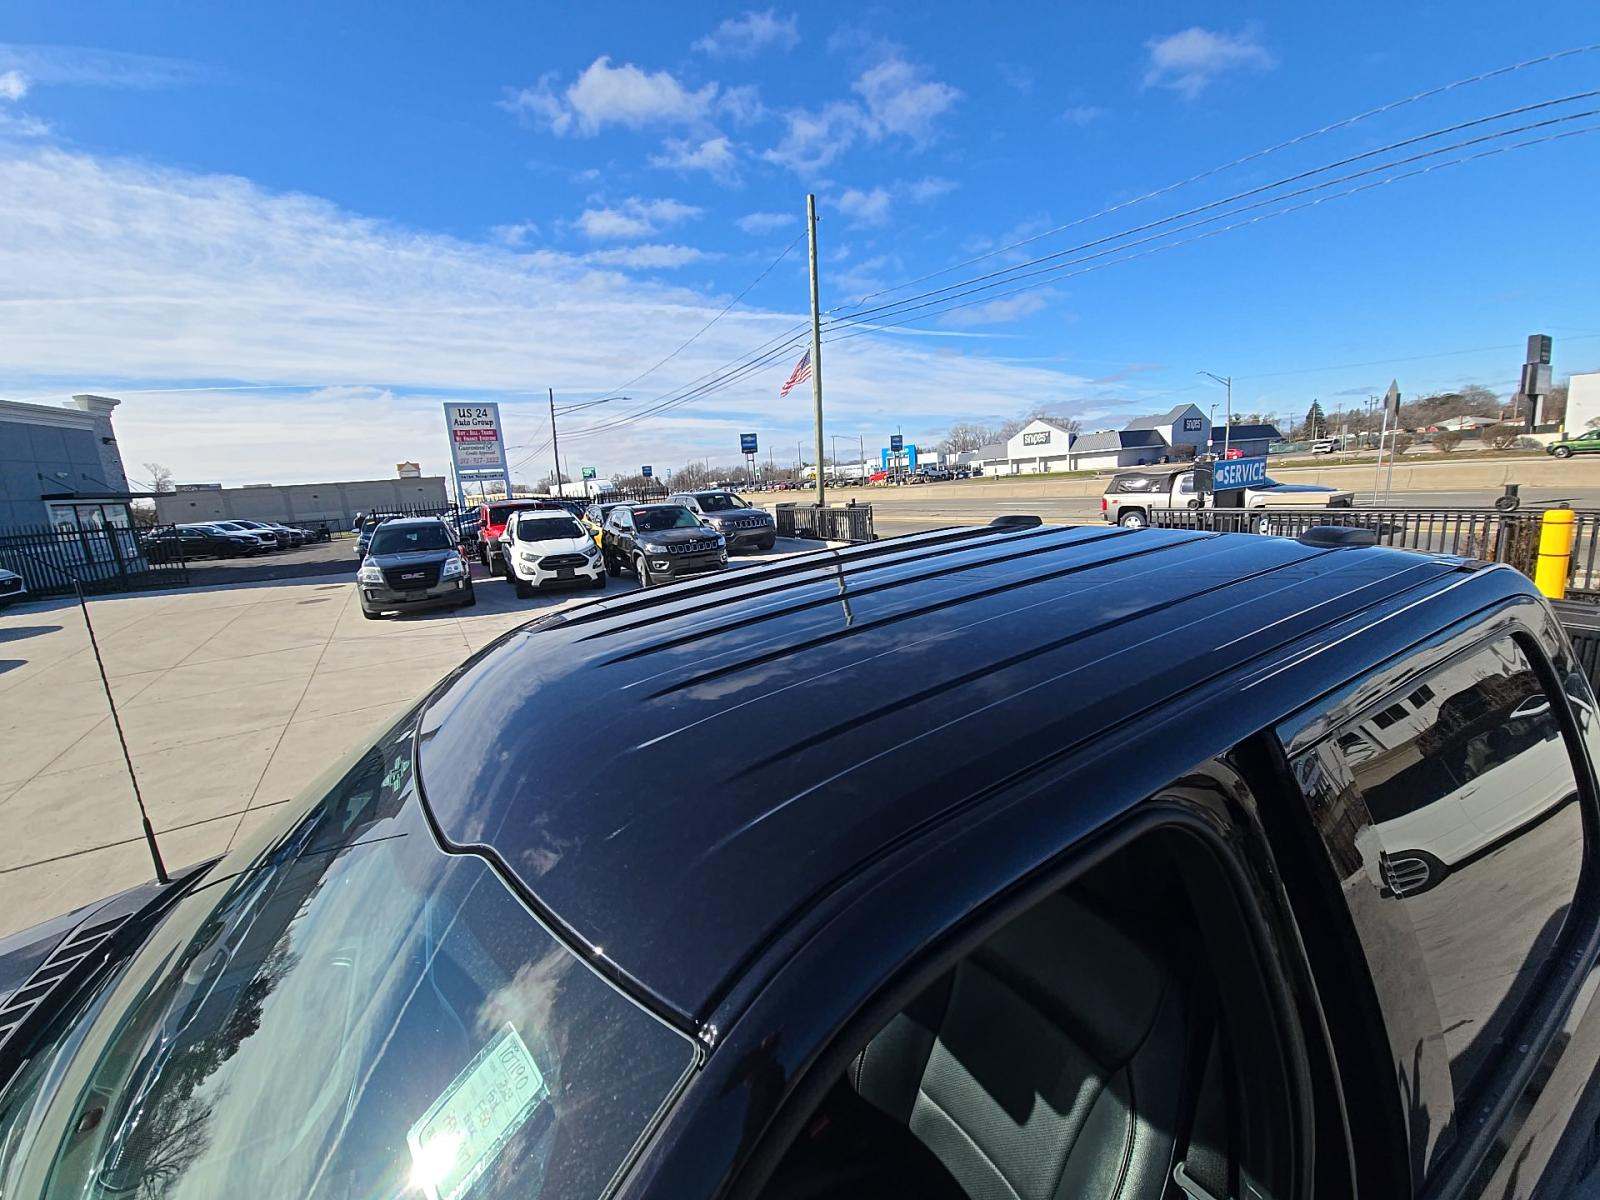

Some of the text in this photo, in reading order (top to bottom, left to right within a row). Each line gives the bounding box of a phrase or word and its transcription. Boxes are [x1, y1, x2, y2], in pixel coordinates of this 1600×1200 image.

[457, 408, 488, 418] US 24
[453, 418, 494, 428] Auto Group
[1223, 462, 1265, 485] SERVICE
[401, 572, 425, 580] GMC
